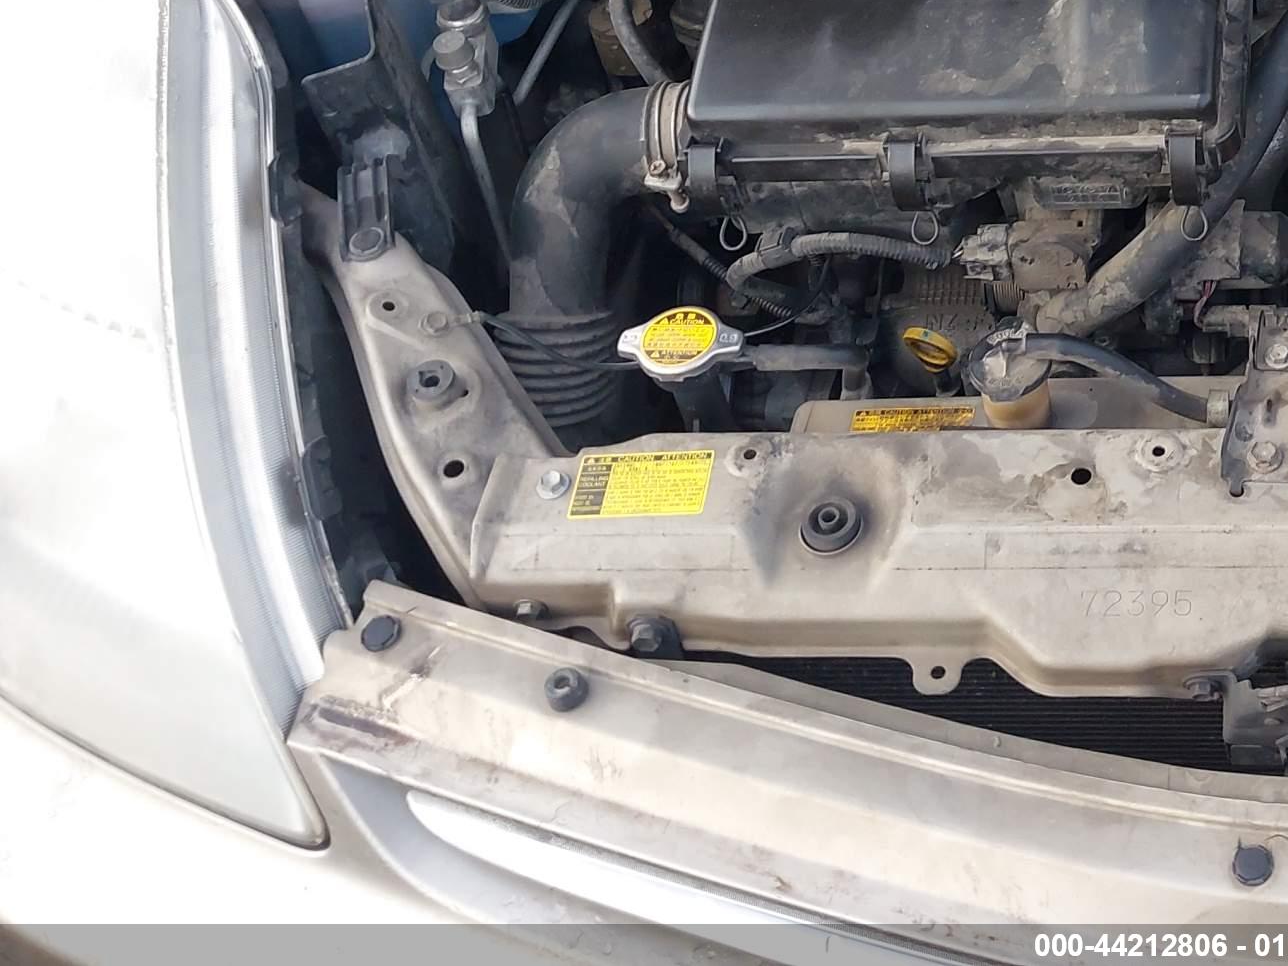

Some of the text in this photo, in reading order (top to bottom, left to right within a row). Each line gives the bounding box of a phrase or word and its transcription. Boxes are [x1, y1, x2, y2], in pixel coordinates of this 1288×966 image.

[618, 455, 655, 463] CAUTION
[660, 452, 708, 461] ATTENTION
[1080, 589, 1193, 617] 72395
